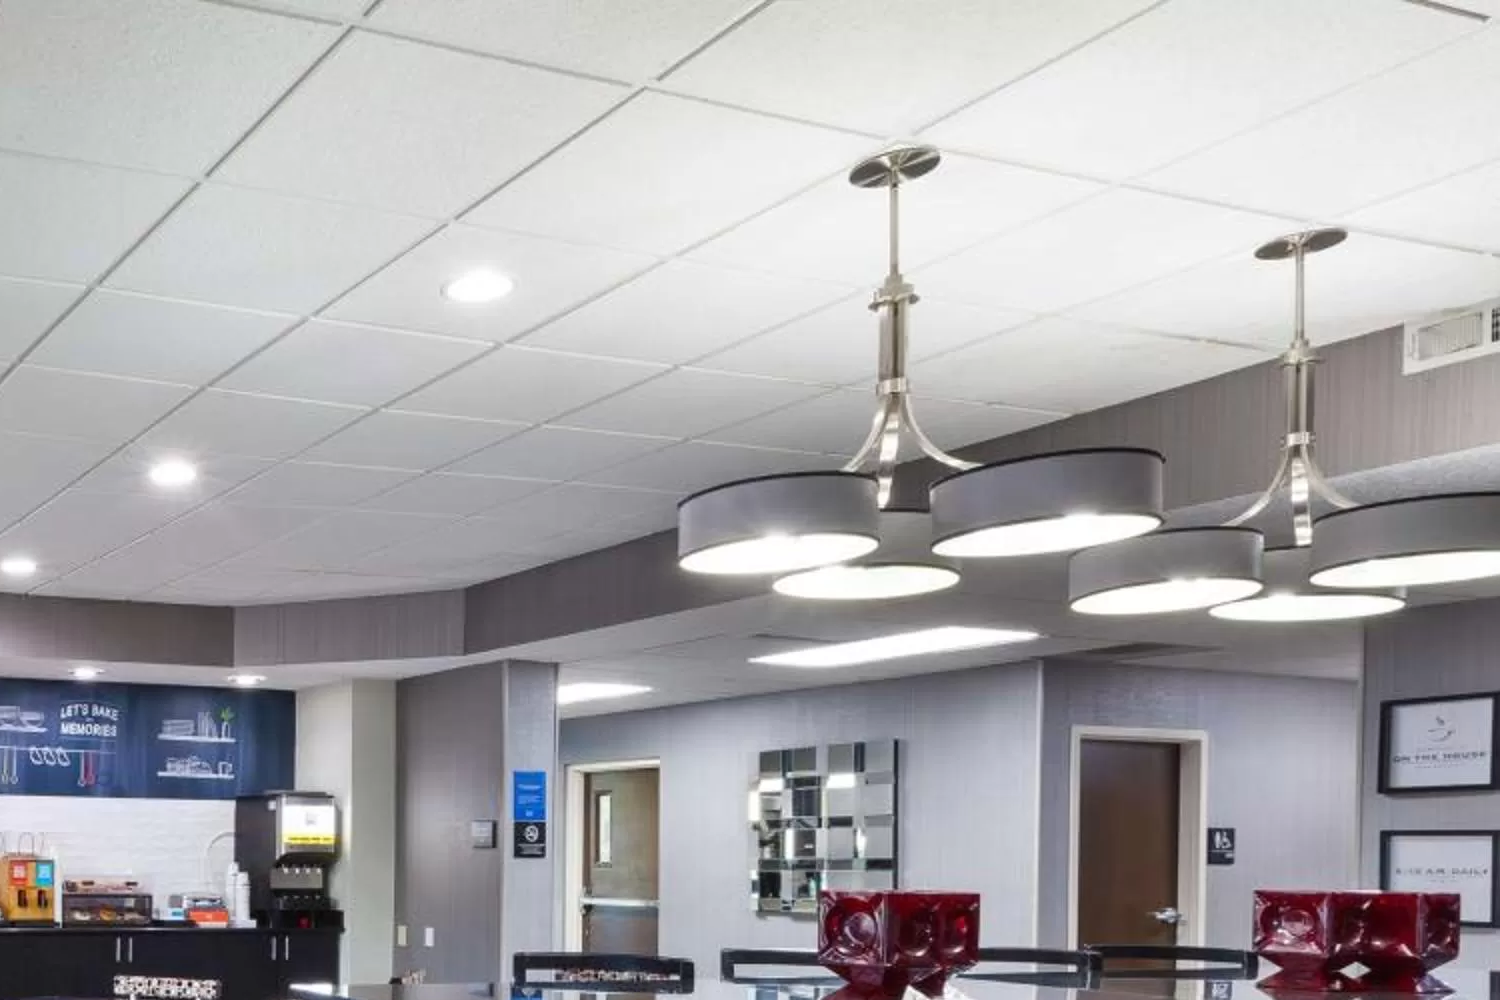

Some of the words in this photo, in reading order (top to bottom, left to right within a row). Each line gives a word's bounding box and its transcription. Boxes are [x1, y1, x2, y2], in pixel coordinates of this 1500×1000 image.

[60, 703, 89, 719] LET'S
[91, 703, 119, 721] BAKE
[60, 722, 117, 737] MEMORIES
